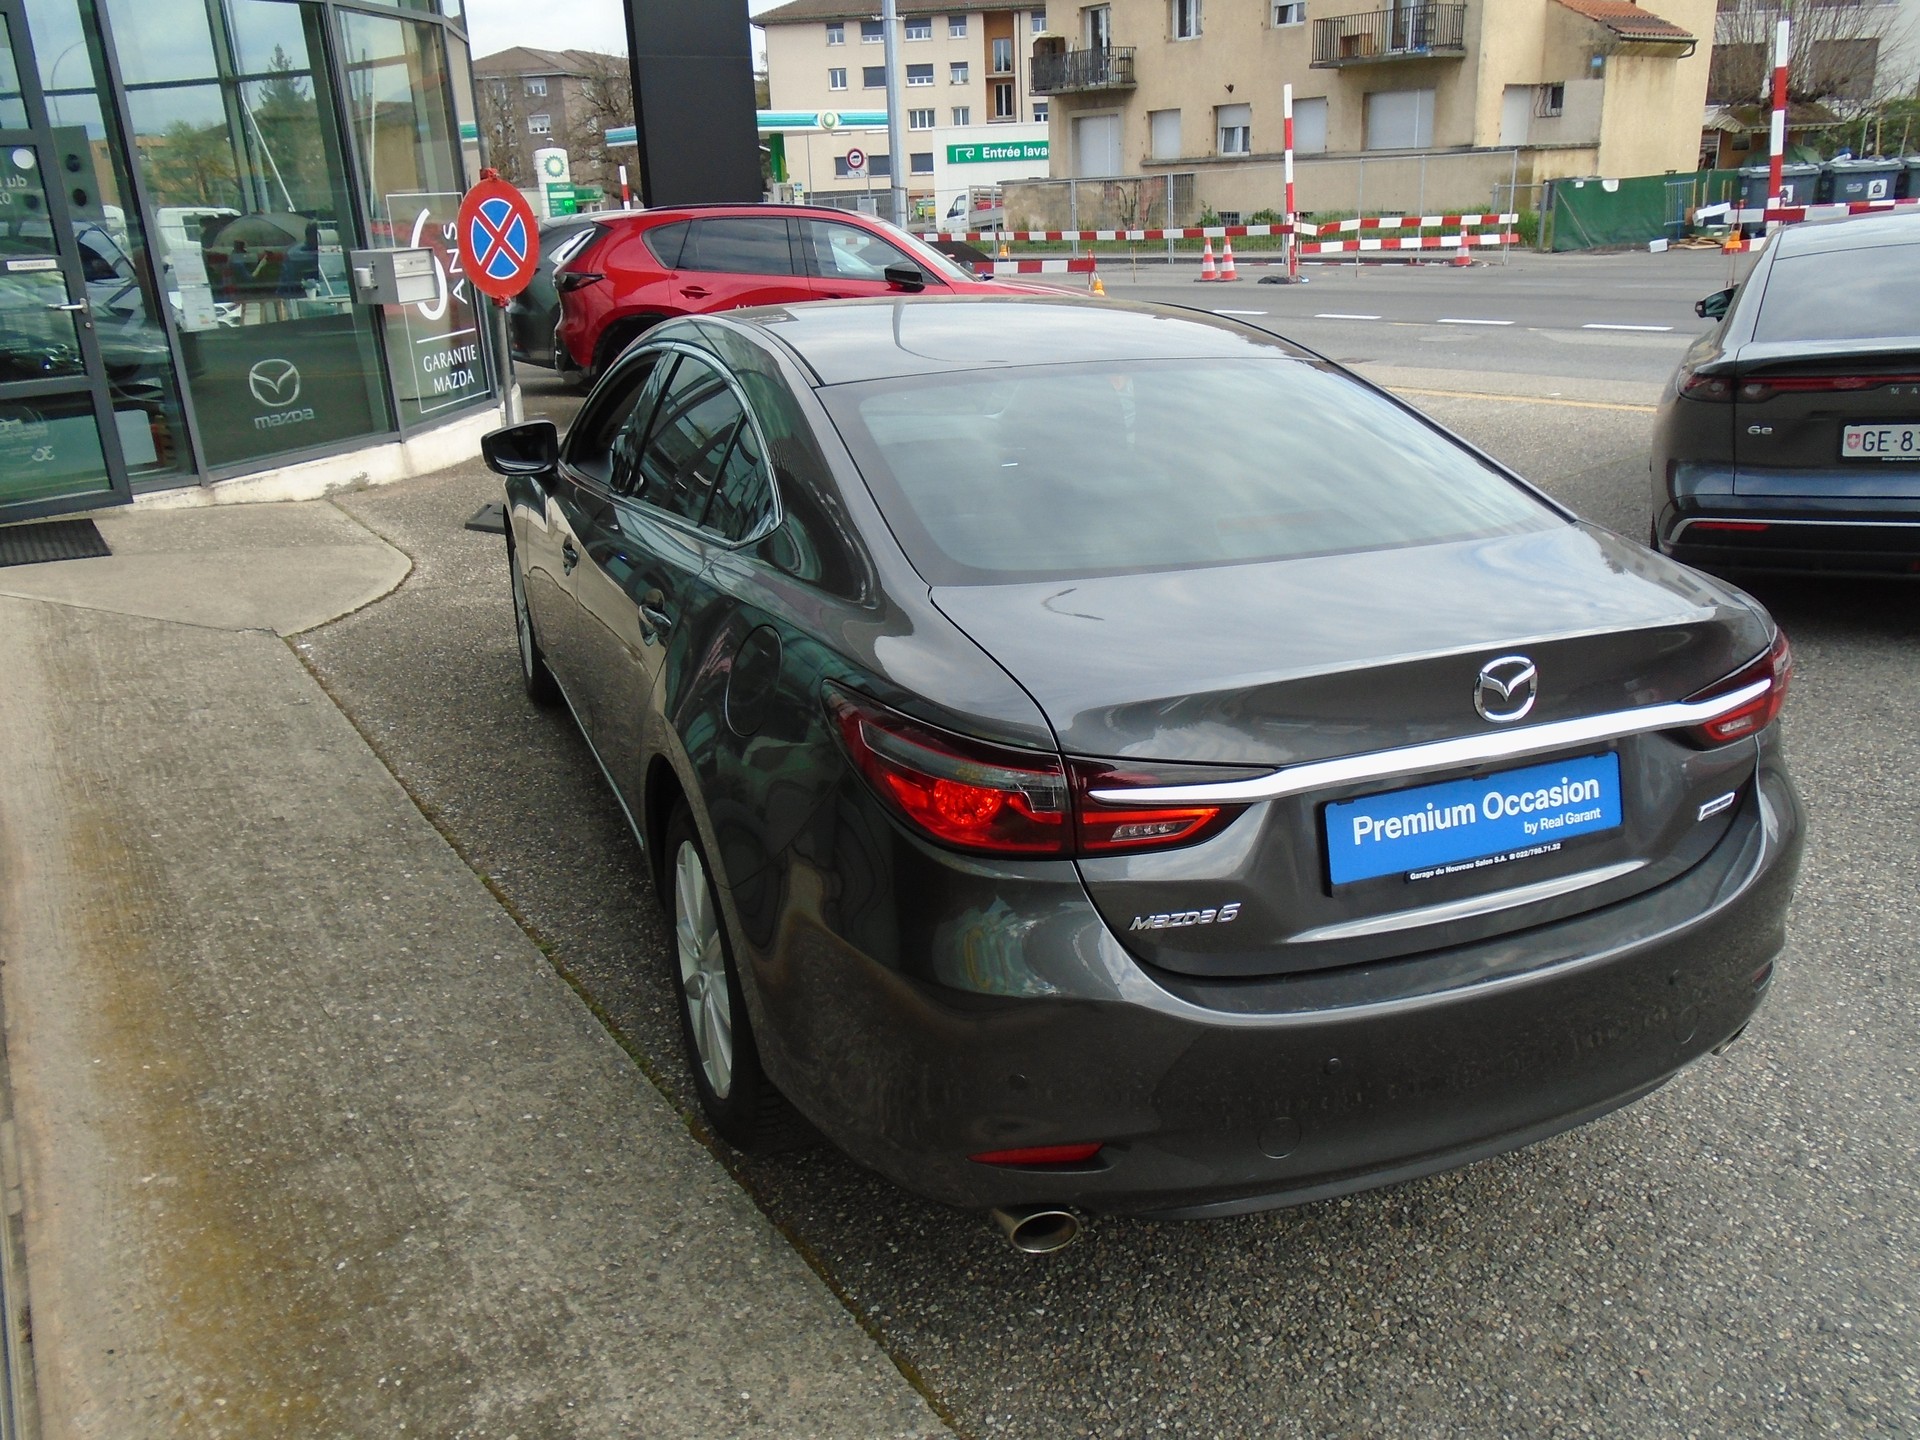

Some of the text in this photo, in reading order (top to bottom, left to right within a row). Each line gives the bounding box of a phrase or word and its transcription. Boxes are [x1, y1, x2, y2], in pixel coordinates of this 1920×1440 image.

[982, 145, 1049, 159] Entrée lava
[442, 221, 468, 305] ANS
[423, 344, 477, 372] GARANTIE
[433, 368, 475, 394] MAZDA
[254, 408, 315, 430] mazda
[1353, 777, 1600, 845] Premium Occasion
[1524, 807, 1602, 835] by Real Garant
[1410, 870, 1434, 881] Garage
[1435, 867, 1445, 876] du
[1445, 862, 1475, 873] Nouveau
[1475, 858, 1494, 868] Salon
